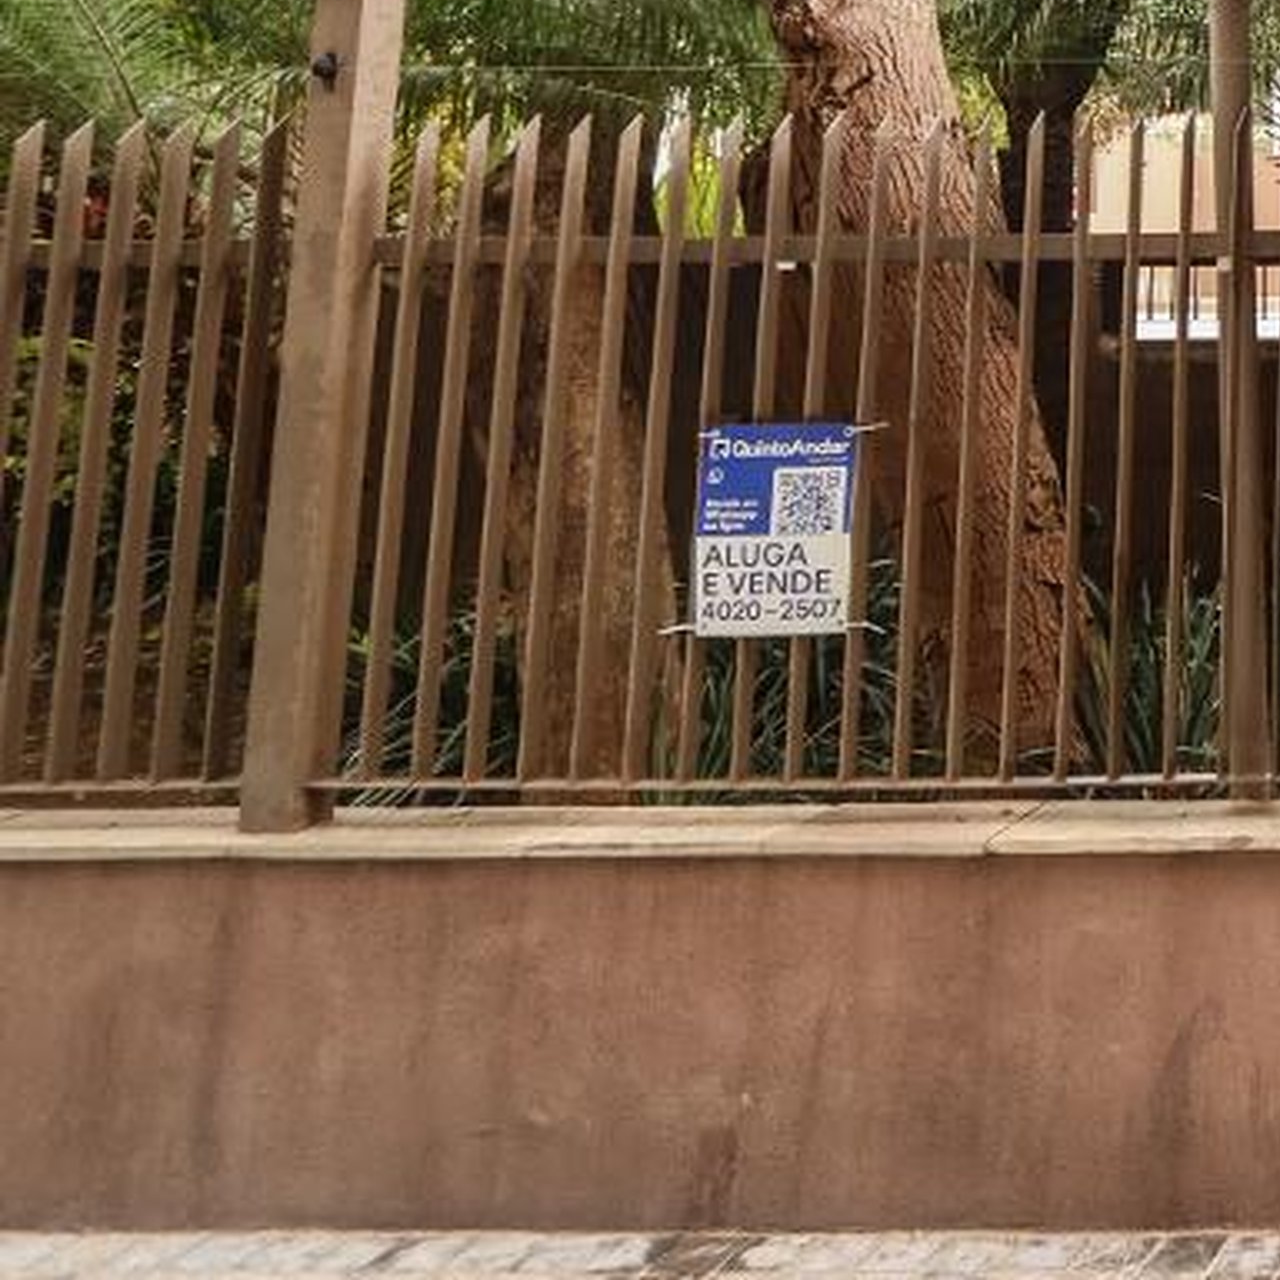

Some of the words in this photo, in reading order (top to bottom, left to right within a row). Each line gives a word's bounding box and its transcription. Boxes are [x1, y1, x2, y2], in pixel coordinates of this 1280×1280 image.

[733, 437, 850, 458] QuintoAndar
[702, 542, 808, 568] ALUGA
[703, 572, 721, 596] E
[727, 569, 832, 595] VENDE
[701, 598, 842, 621] 4020-2507
